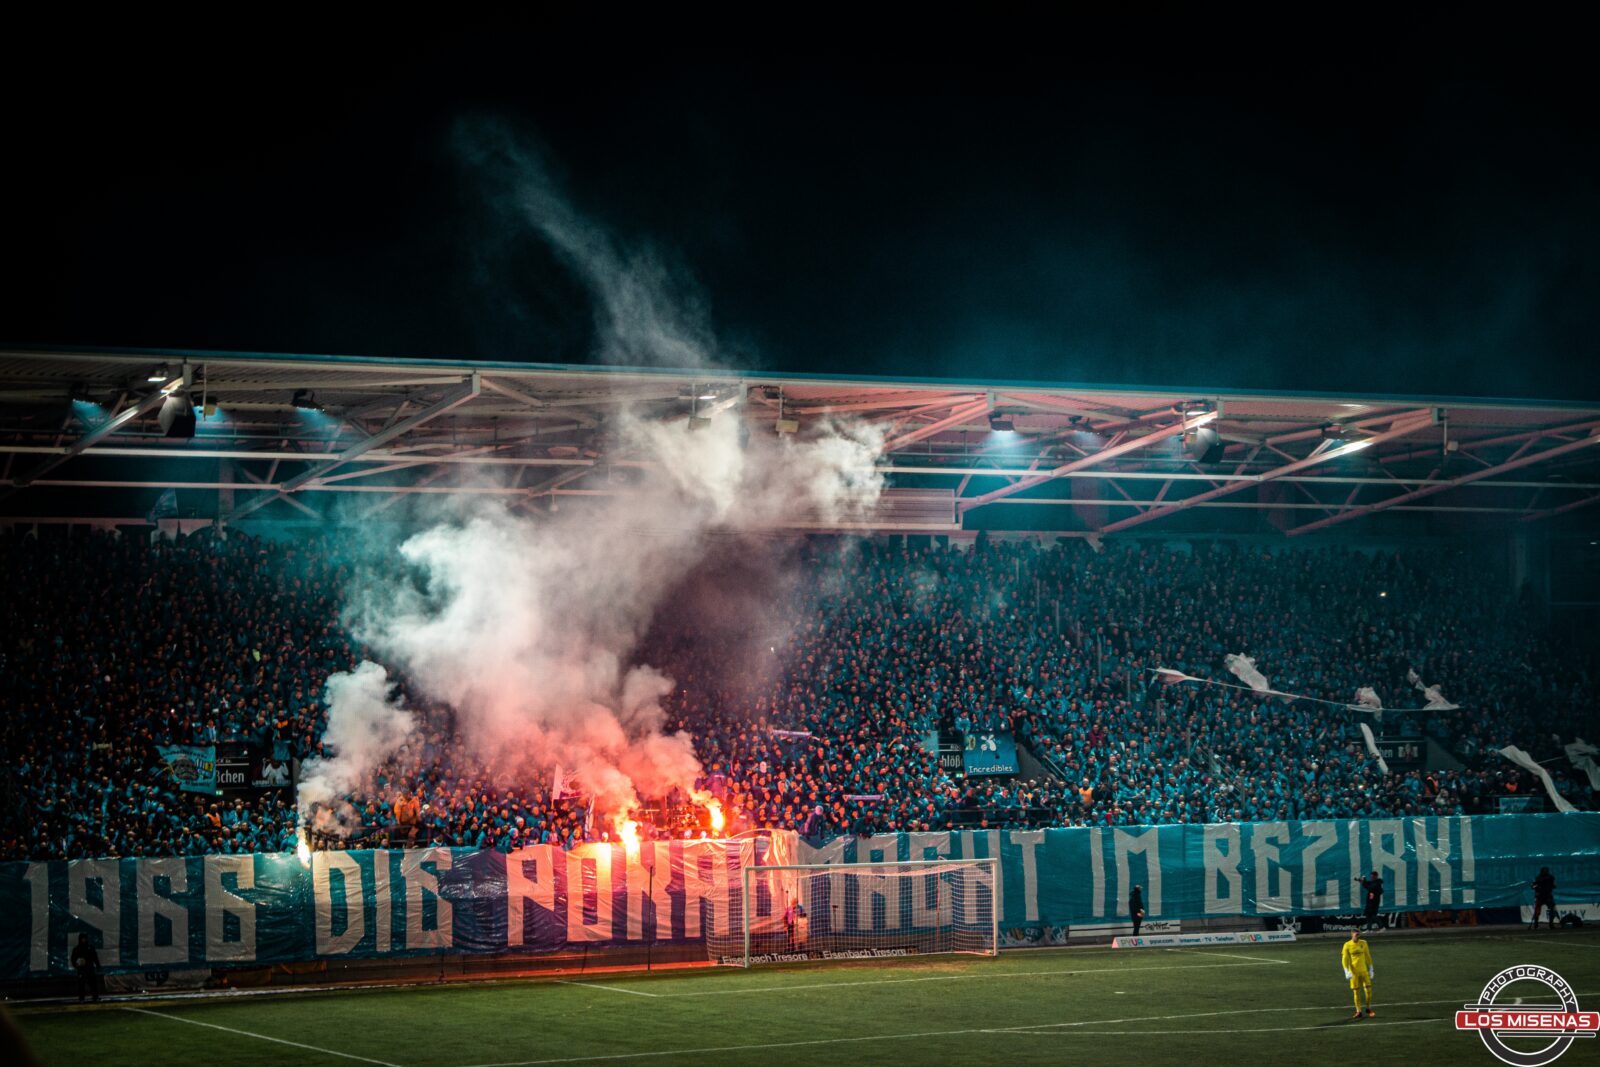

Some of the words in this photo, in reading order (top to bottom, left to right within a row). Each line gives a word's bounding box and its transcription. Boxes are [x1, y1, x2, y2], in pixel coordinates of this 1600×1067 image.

[968, 764, 1013, 774] Incredibles
[22, 854, 257, 972] 1966
[1089, 825, 1163, 918] IM
[1203, 815, 1477, 915] BEZIRK!
[823, 949, 871, 959] Eisenbach
